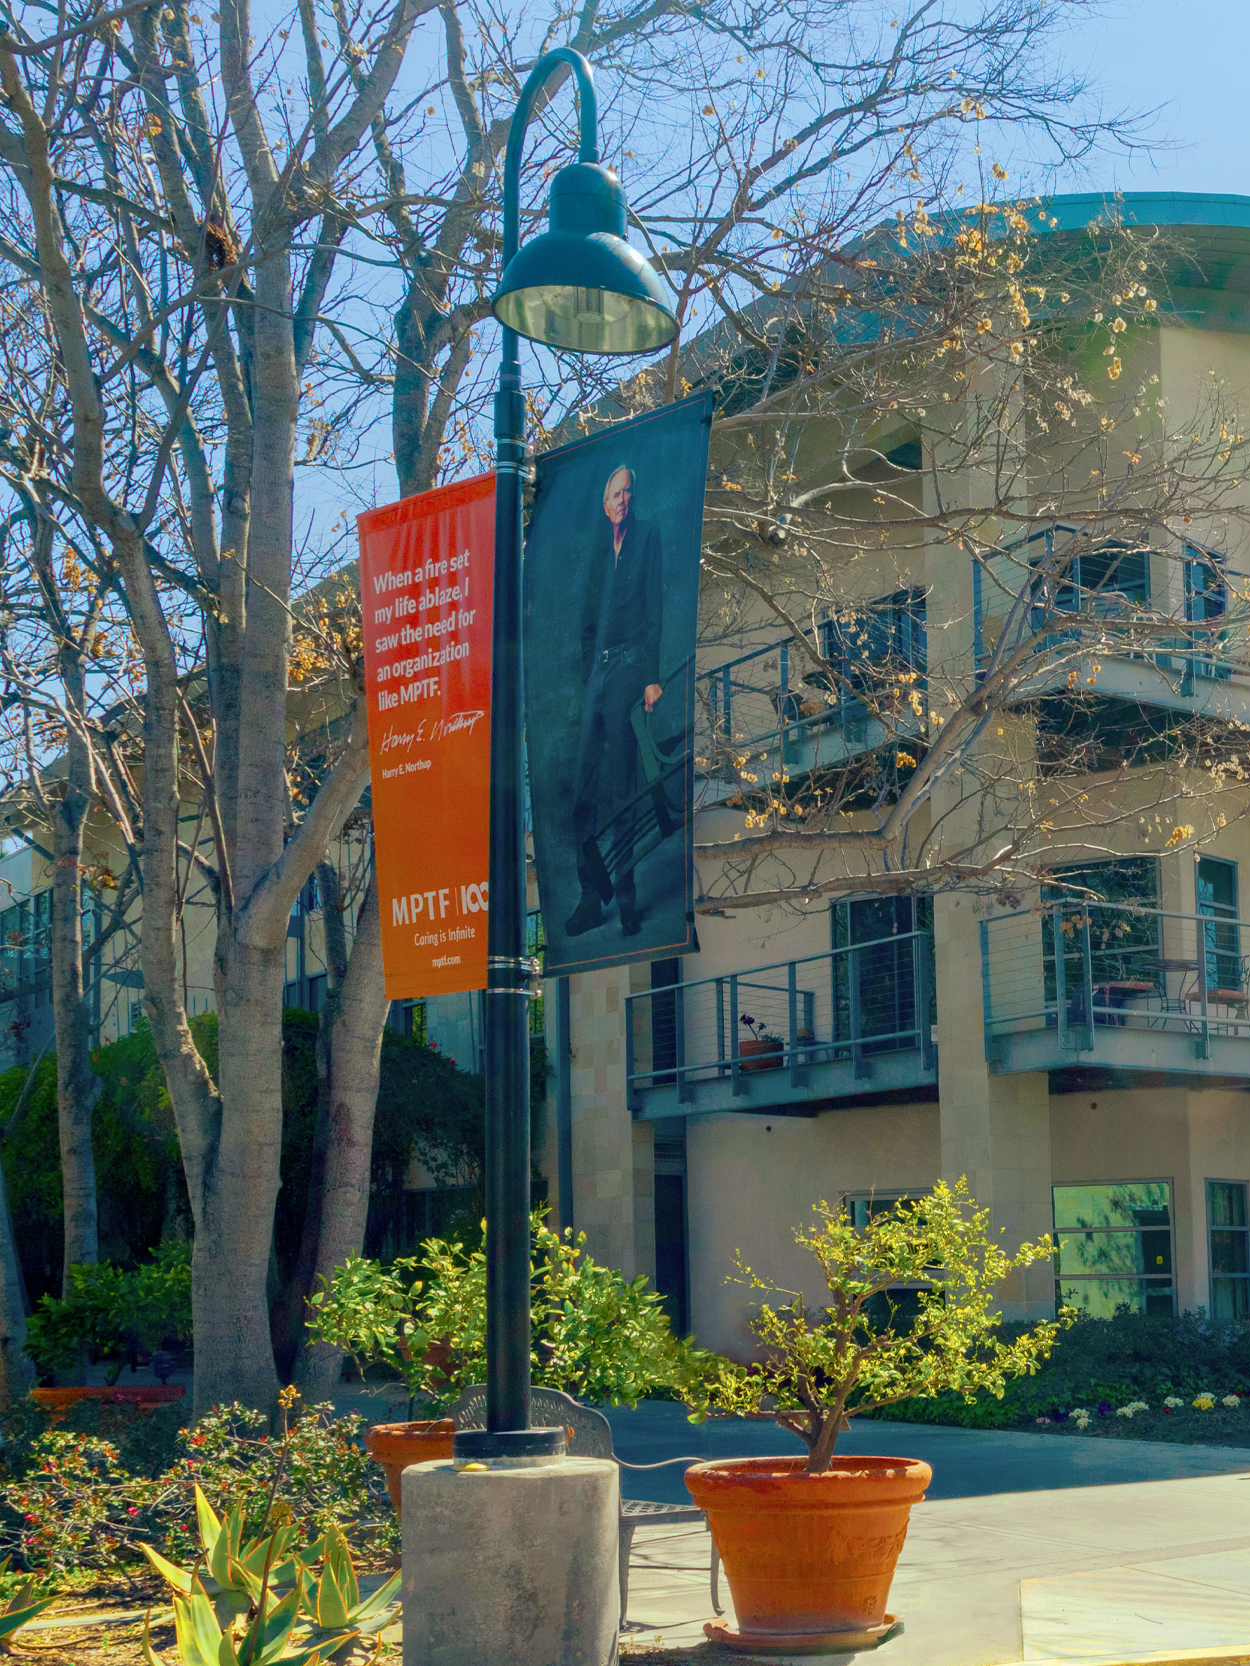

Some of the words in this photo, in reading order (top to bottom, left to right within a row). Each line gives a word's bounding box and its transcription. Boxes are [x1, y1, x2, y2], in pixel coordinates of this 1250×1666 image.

[373, 571, 412, 594] When
[414, 567, 423, 583] a
[425, 558, 448, 579] fire
[449, 549, 470, 572] set
[374, 605, 393, 625] my
[395, 595, 416, 618] life
[418, 585, 463, 611] ablaze,
[464, 576, 469, 596] I
[375, 633, 399, 653] saw
[400, 624, 423, 646] the
[424, 611, 456, 639] need
[457, 609, 476, 629] for
[377, 665, 391, 682] an
[392, 640, 470, 678] organization
[377, 690, 399, 712] like
[400, 676, 441, 705] MPTF.
[382, 768, 398, 780] Harry
[398, 764, 405, 775] E.
[405, 759, 432, 774] Northup
[392, 888, 450, 927] MPTF
[414, 932, 439, 946] Caring
[439, 929, 447, 943] is
[448, 925, 476, 942] Infinite
[432, 955, 460, 968] mptf.com
